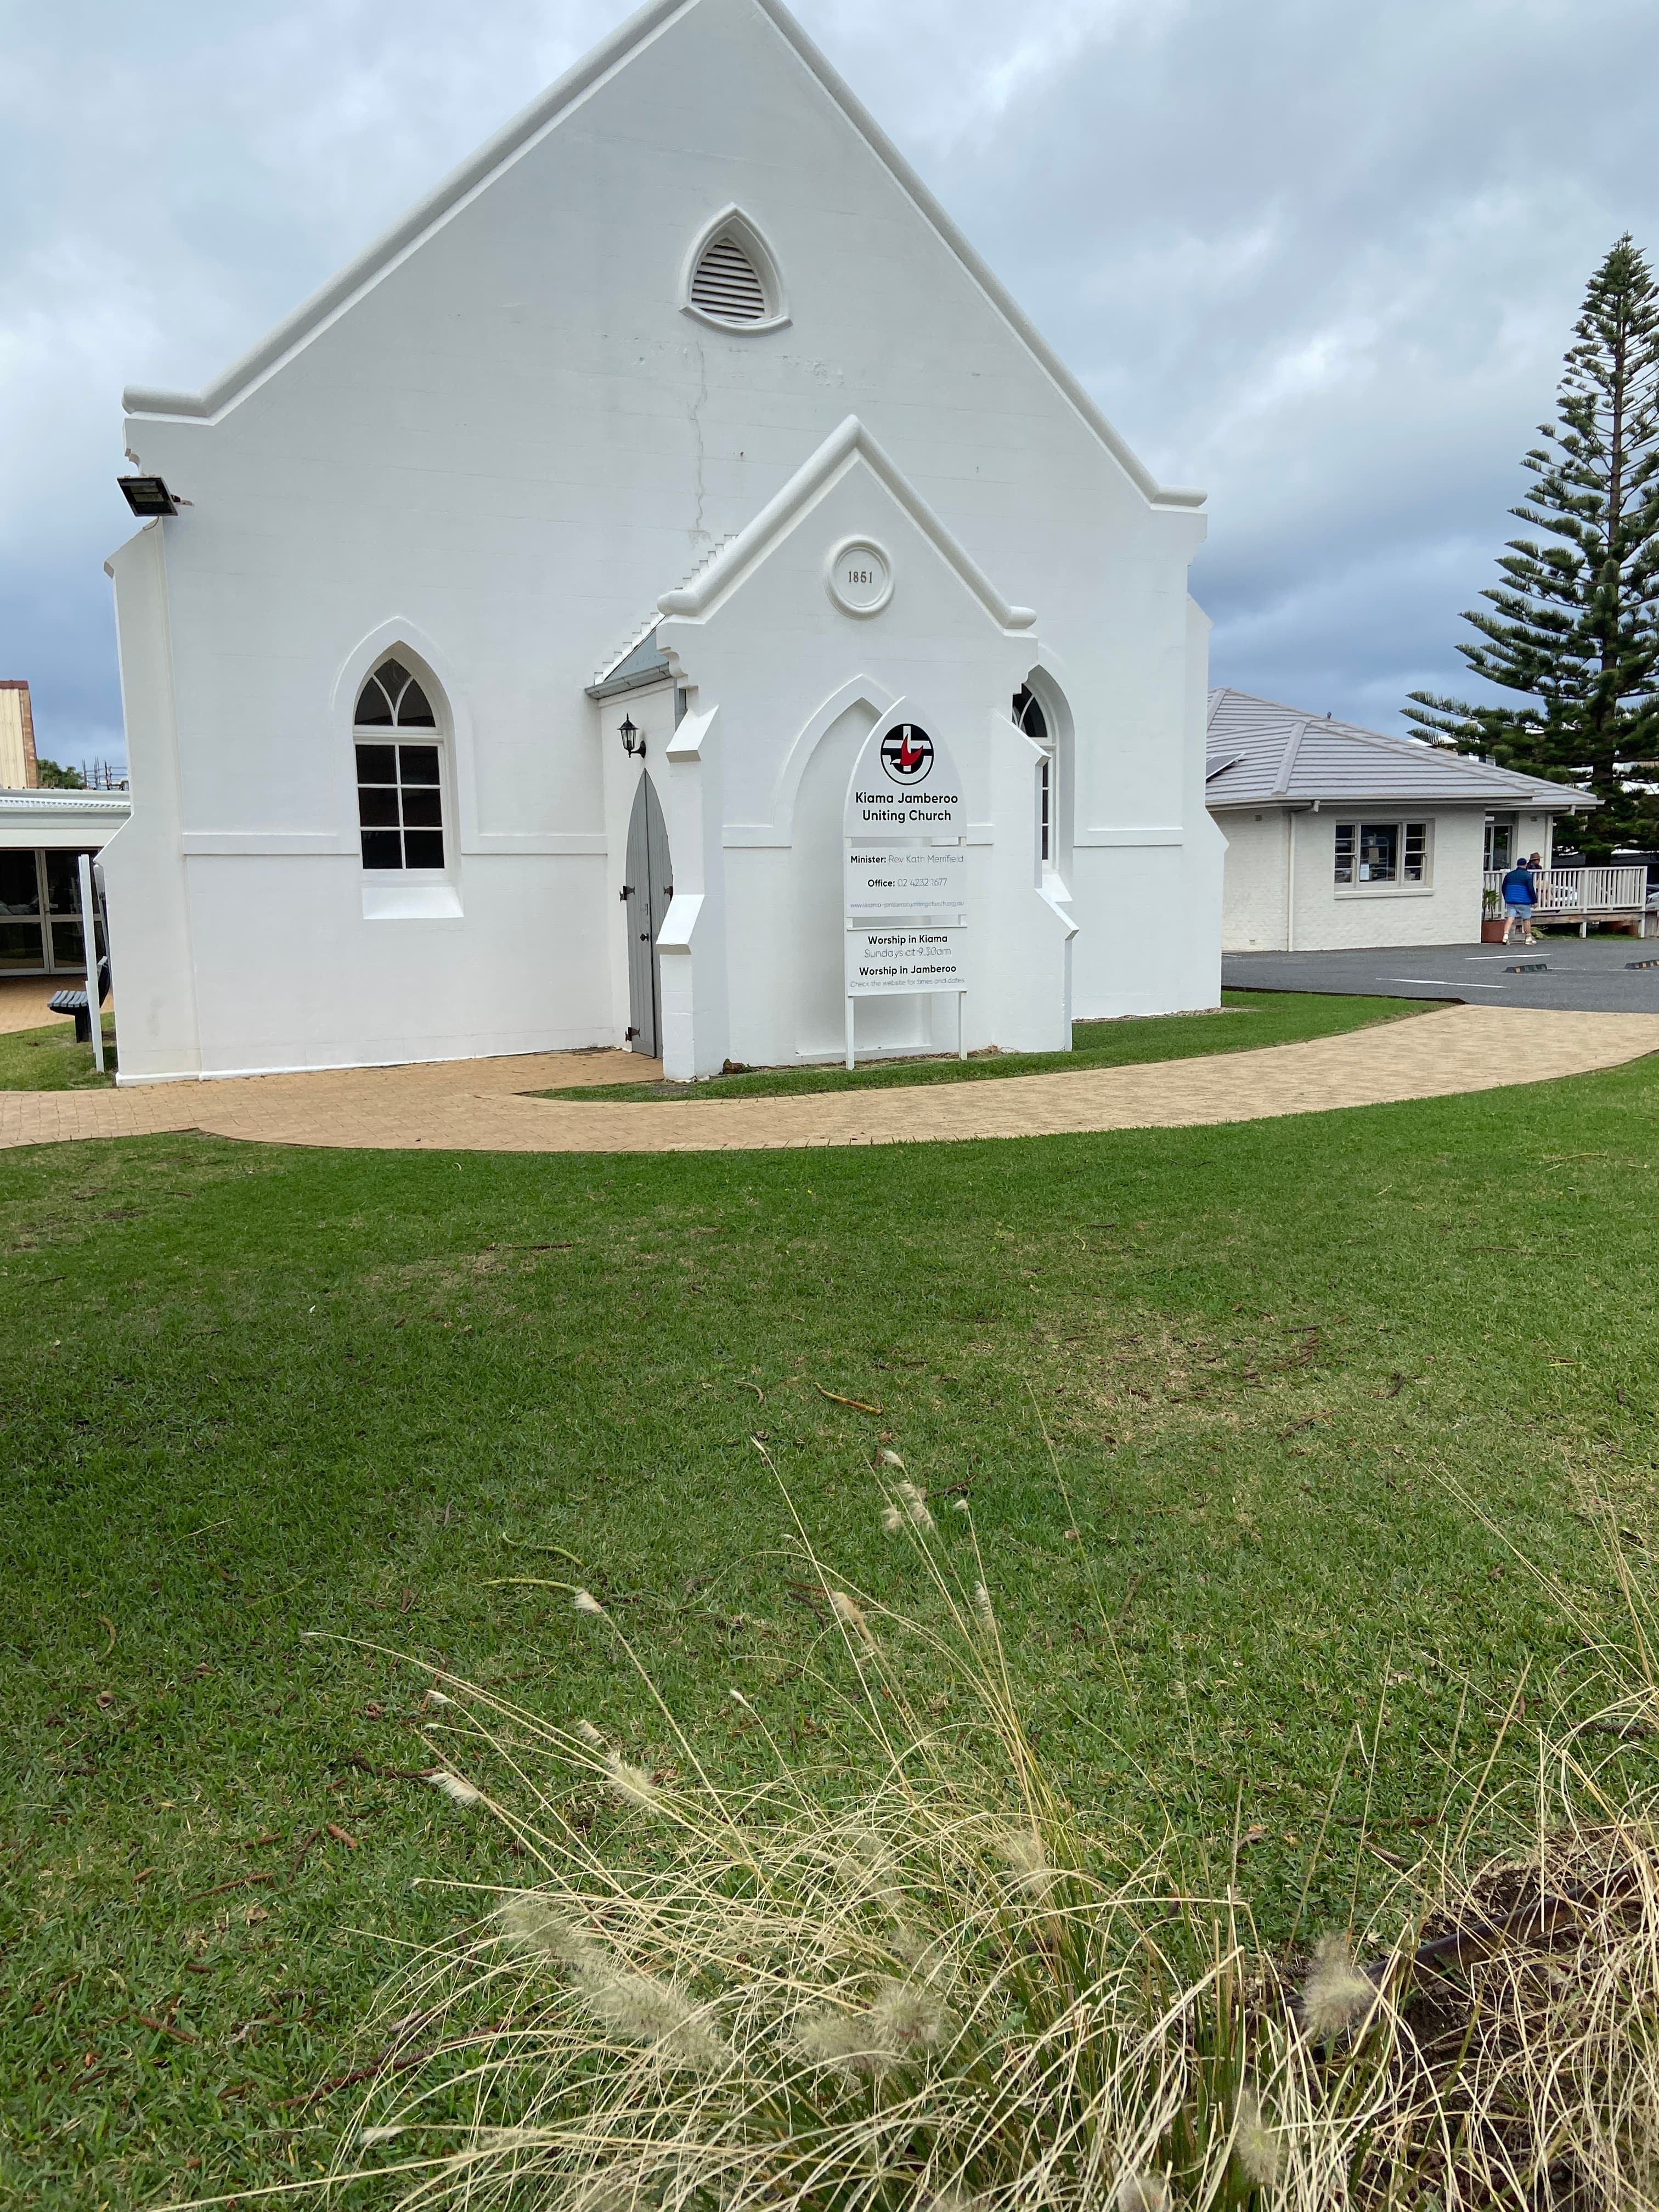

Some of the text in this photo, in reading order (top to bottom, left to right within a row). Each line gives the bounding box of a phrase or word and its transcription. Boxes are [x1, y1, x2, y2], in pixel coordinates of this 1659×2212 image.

[856, 792, 958, 804] Kiama Jamberoo
[863, 810, 951, 823] Uniting Church
[927, 854, 963, 862] Merrifield
[867, 879, 895, 887] Office:
[910, 878, 928, 887] 4232
[932, 878, 947, 886] 1677
[868, 934, 947, 945] Worship in Kiama
[864, 947, 951, 959] Sundays at 9.30am
[859, 964, 956, 976] Worship in Jamberoo
